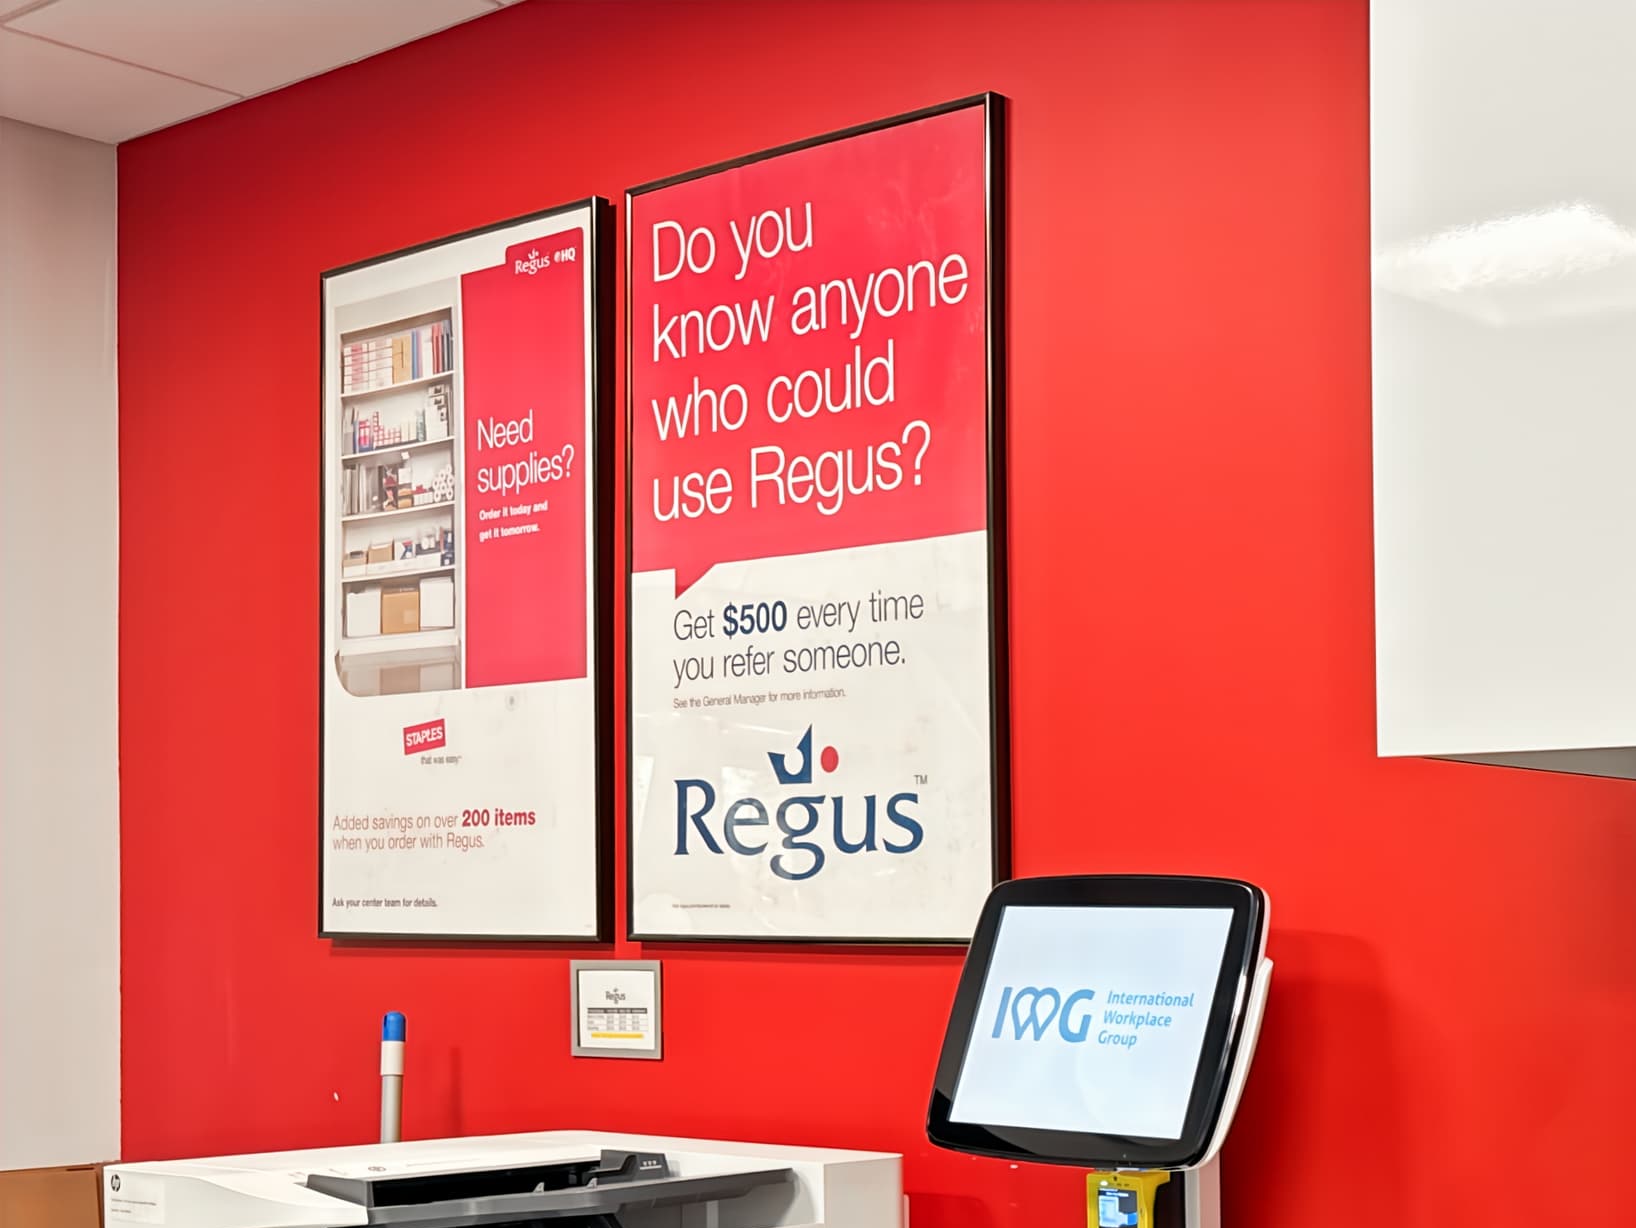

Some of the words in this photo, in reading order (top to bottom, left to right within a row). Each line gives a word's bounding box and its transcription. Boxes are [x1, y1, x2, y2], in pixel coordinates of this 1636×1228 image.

[651, 218, 716, 283] Do
[729, 201, 814, 281] you
[515, 255, 550, 275] Regus
[651, 294, 775, 362] know
[790, 252, 969, 341] anyone
[651, 375, 748, 441] who
[767, 338, 895, 422] could
[477, 408, 533, 452] Need
[477, 444, 575, 497] supplies?
[651, 472, 733, 522] use
[750, 420, 931, 517] Regus?
[479, 507, 502, 521] Order
[503, 506, 509, 517] it
[510, 503, 531, 516] today
[533, 500, 548, 512] and
[479, 529, 492, 543] get
[501, 523, 540, 537] tomorrow.
[673, 608, 715, 641] Get
[722, 600, 788, 640] $500
[796, 600, 861, 633] every
[869, 589, 925, 623] time
[673, 655, 714, 689] you
[723, 645, 775, 677] refer
[783, 640, 906, 673] someone.
[673, 698, 688, 709] See
[690, 697, 701, 708] the
[703, 695, 731, 707] General
[733, 692, 766, 706] Manager
[768, 692, 778, 702] for
[780, 692, 801, 702] more
[406, 726, 443, 748] STAPLES
[333, 815, 369, 831] Added
[372, 814, 414, 833] savings
[416, 816, 431, 829] on
[434, 814, 458, 829] over
[462, 809, 490, 827] 200
[494, 808, 536, 827] items
[674, 778, 925, 882] Regus
[333, 836, 361, 850] when
[365, 837, 385, 852] you
[388, 834, 416, 850] order
[420, 833, 443, 848] with
[446, 832, 485, 851] Regus.
[332, 897, 345, 907] Ask
[346, 898, 360, 909] your
[361, 898, 383, 907] center
[384, 898, 401, 907] team
[1107, 990, 1195, 1008] International
[991, 986, 1096, 1043] IWG
[1103, 1010, 1172, 1029] Workplace
[1097, 1029, 1138, 1050] Group
